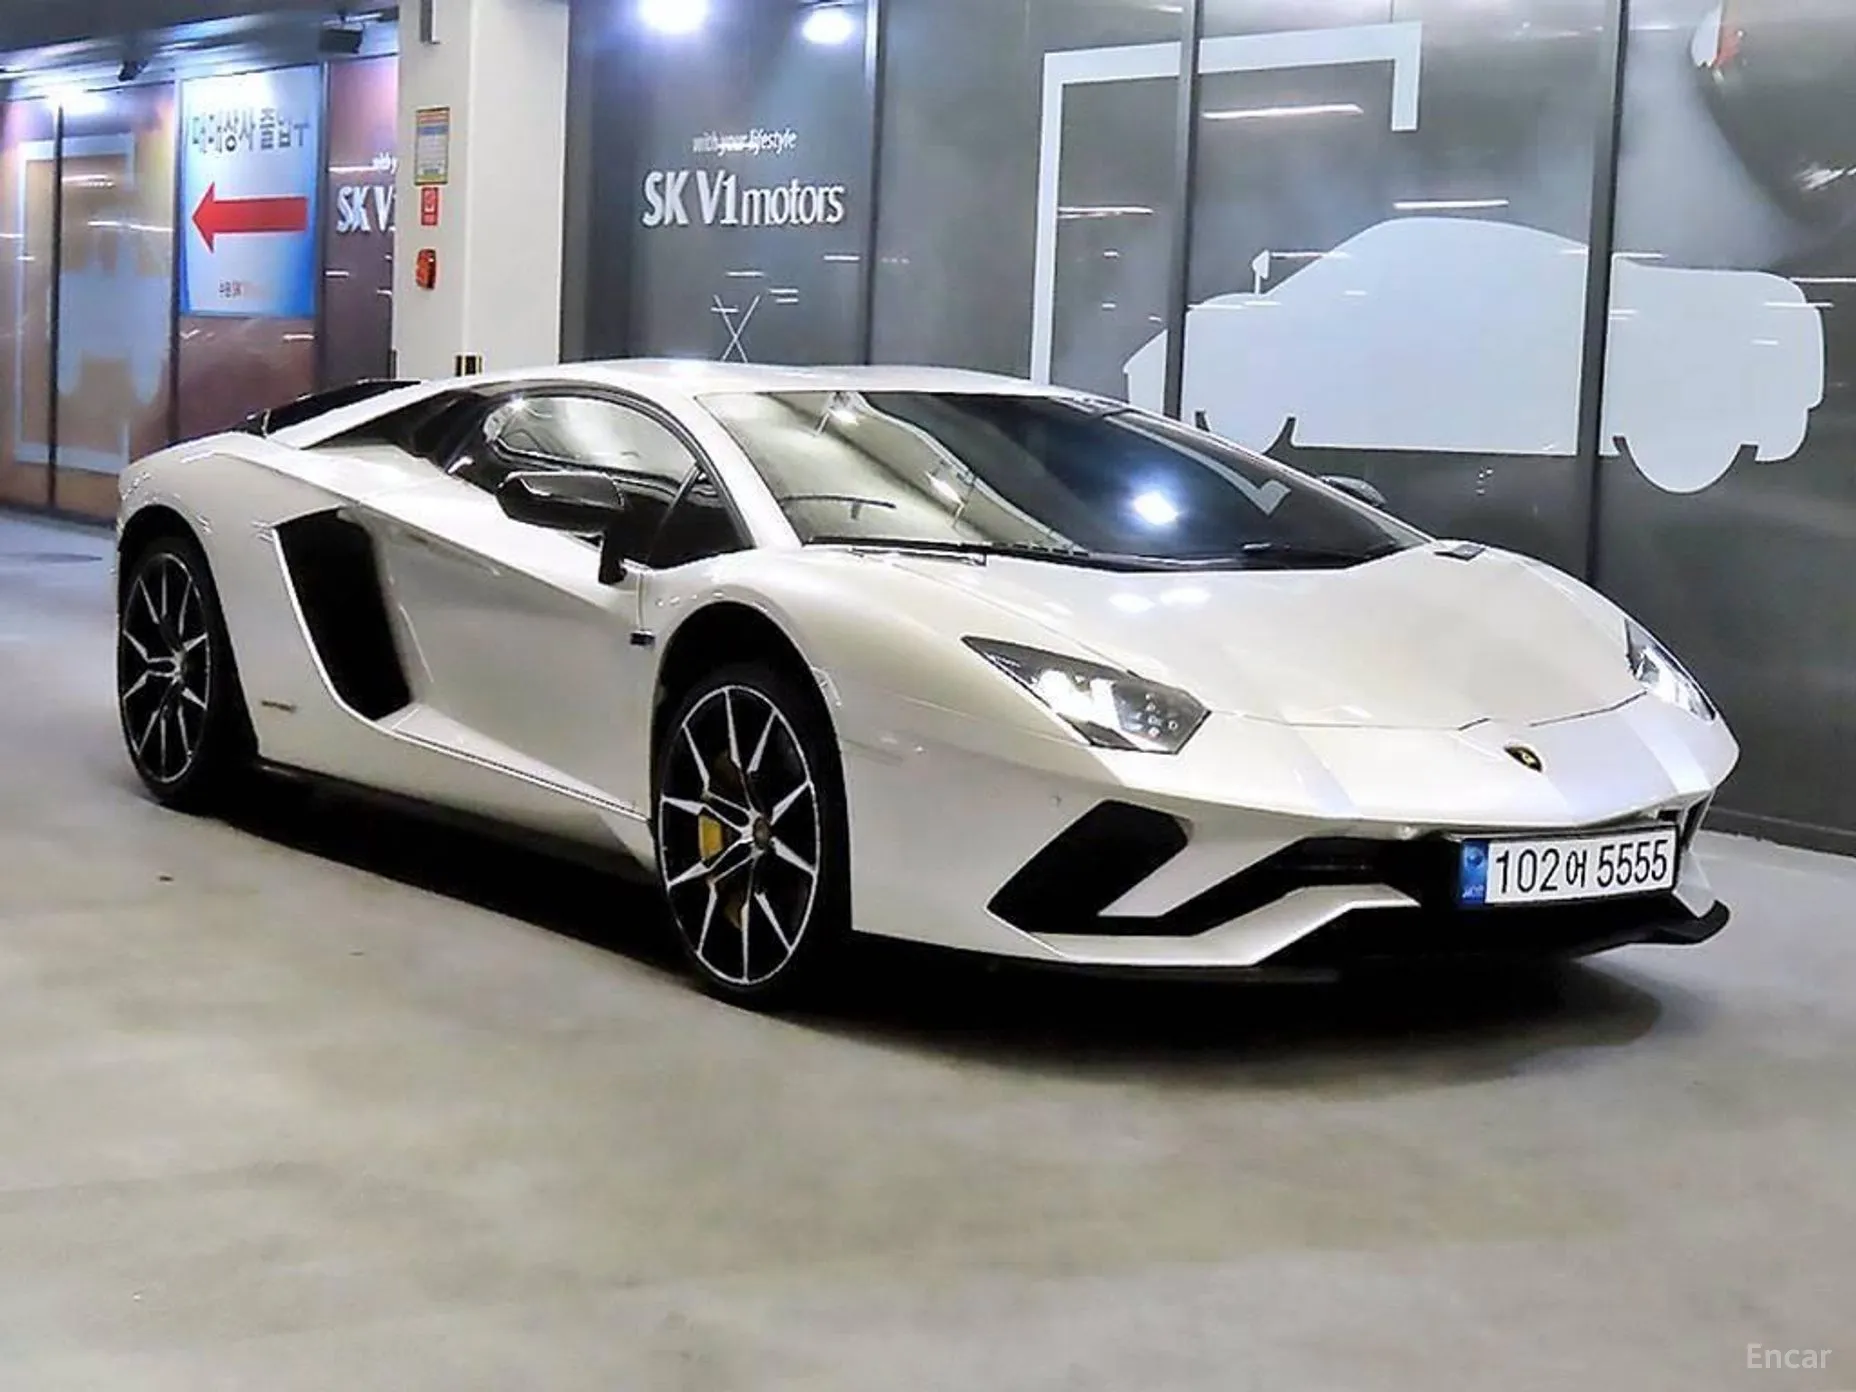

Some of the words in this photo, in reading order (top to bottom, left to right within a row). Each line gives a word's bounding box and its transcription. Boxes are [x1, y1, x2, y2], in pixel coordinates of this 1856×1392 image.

[336, 185, 371, 232] SK
[642, 171, 690, 226] SK
[1597, 839, 1669, 888] 5555
